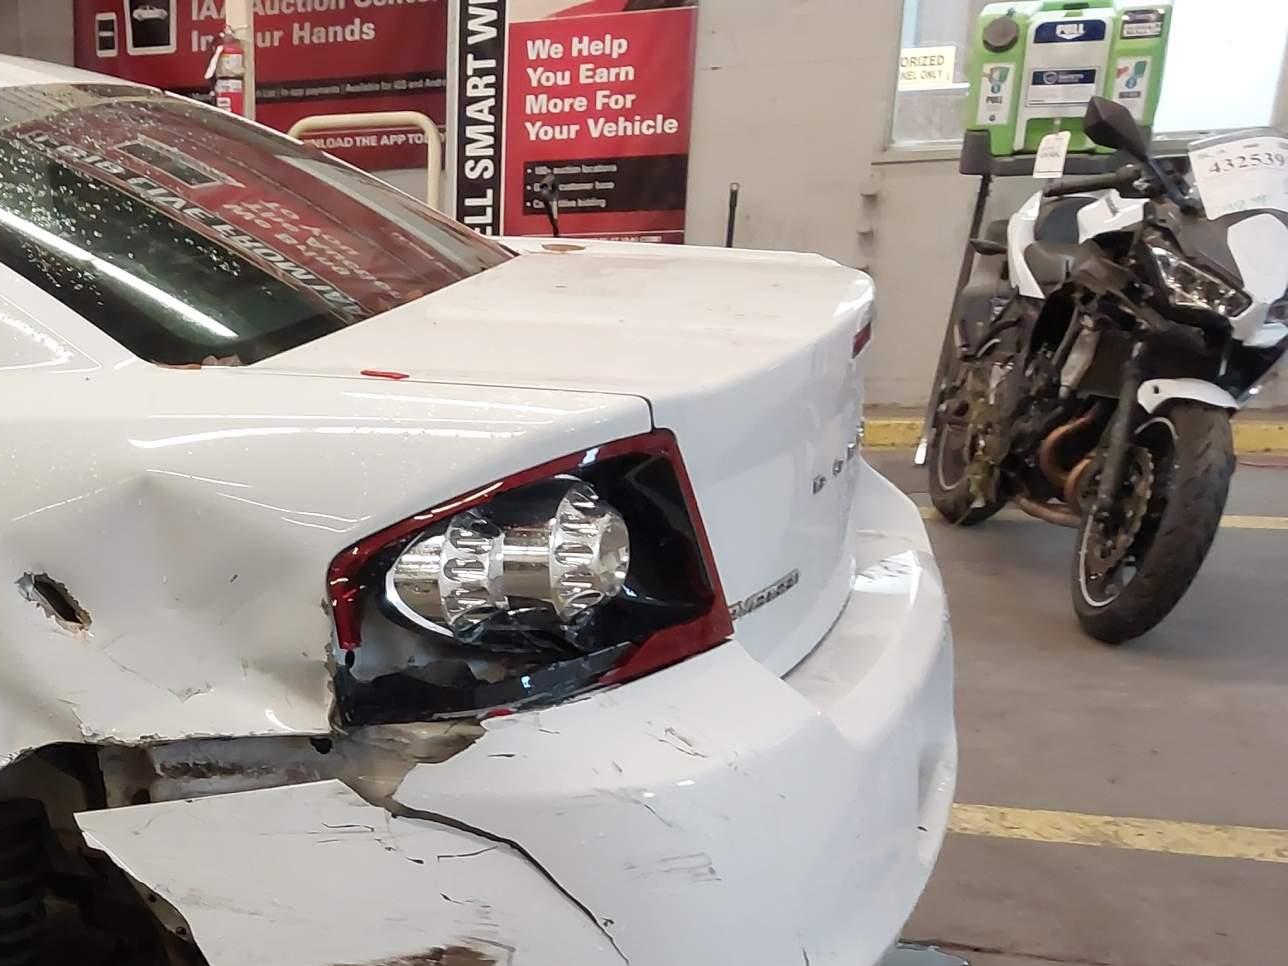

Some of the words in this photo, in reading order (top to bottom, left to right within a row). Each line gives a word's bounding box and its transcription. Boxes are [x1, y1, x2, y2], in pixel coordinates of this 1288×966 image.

[292, 17, 376, 46] Hands
[526, 39, 563, 59] We
[571, 34, 628, 58] Help
[900, 55, 945, 68] ORIZED
[526, 67, 571, 87] You
[579, 64, 635, 83] Earn
[524, 94, 588, 115] More
[595, 90, 636, 110] For
[465, 53, 497, 180] SMART
[524, 120, 580, 141] Your
[587, 115, 679, 138] Vehicle
[355, 136, 377, 147] THE
[380, 134, 407, 146] APP
